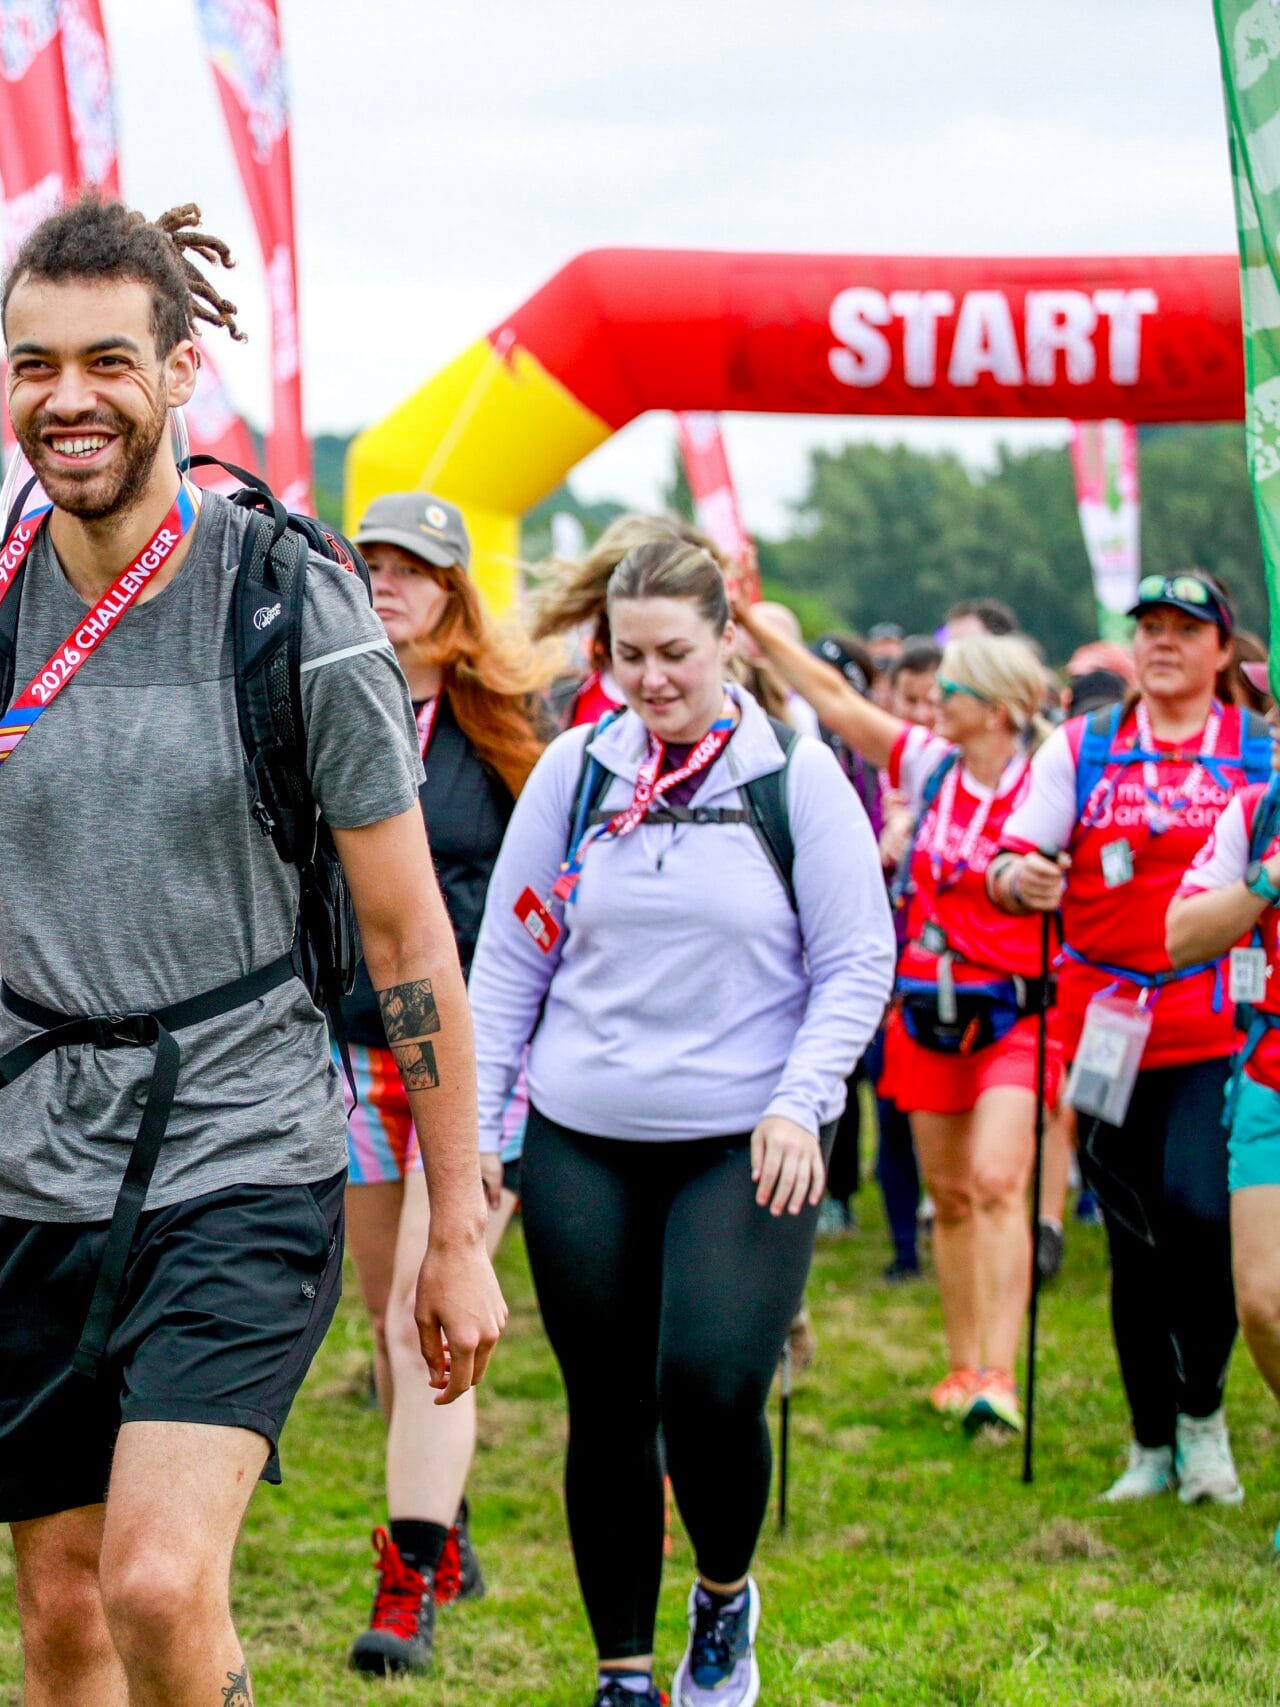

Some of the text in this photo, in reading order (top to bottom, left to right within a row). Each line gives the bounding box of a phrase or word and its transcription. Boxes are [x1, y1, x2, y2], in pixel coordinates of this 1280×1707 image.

[828, 287, 1159, 388] START
[31, 528, 180, 704] 2026 CHALLENGER
